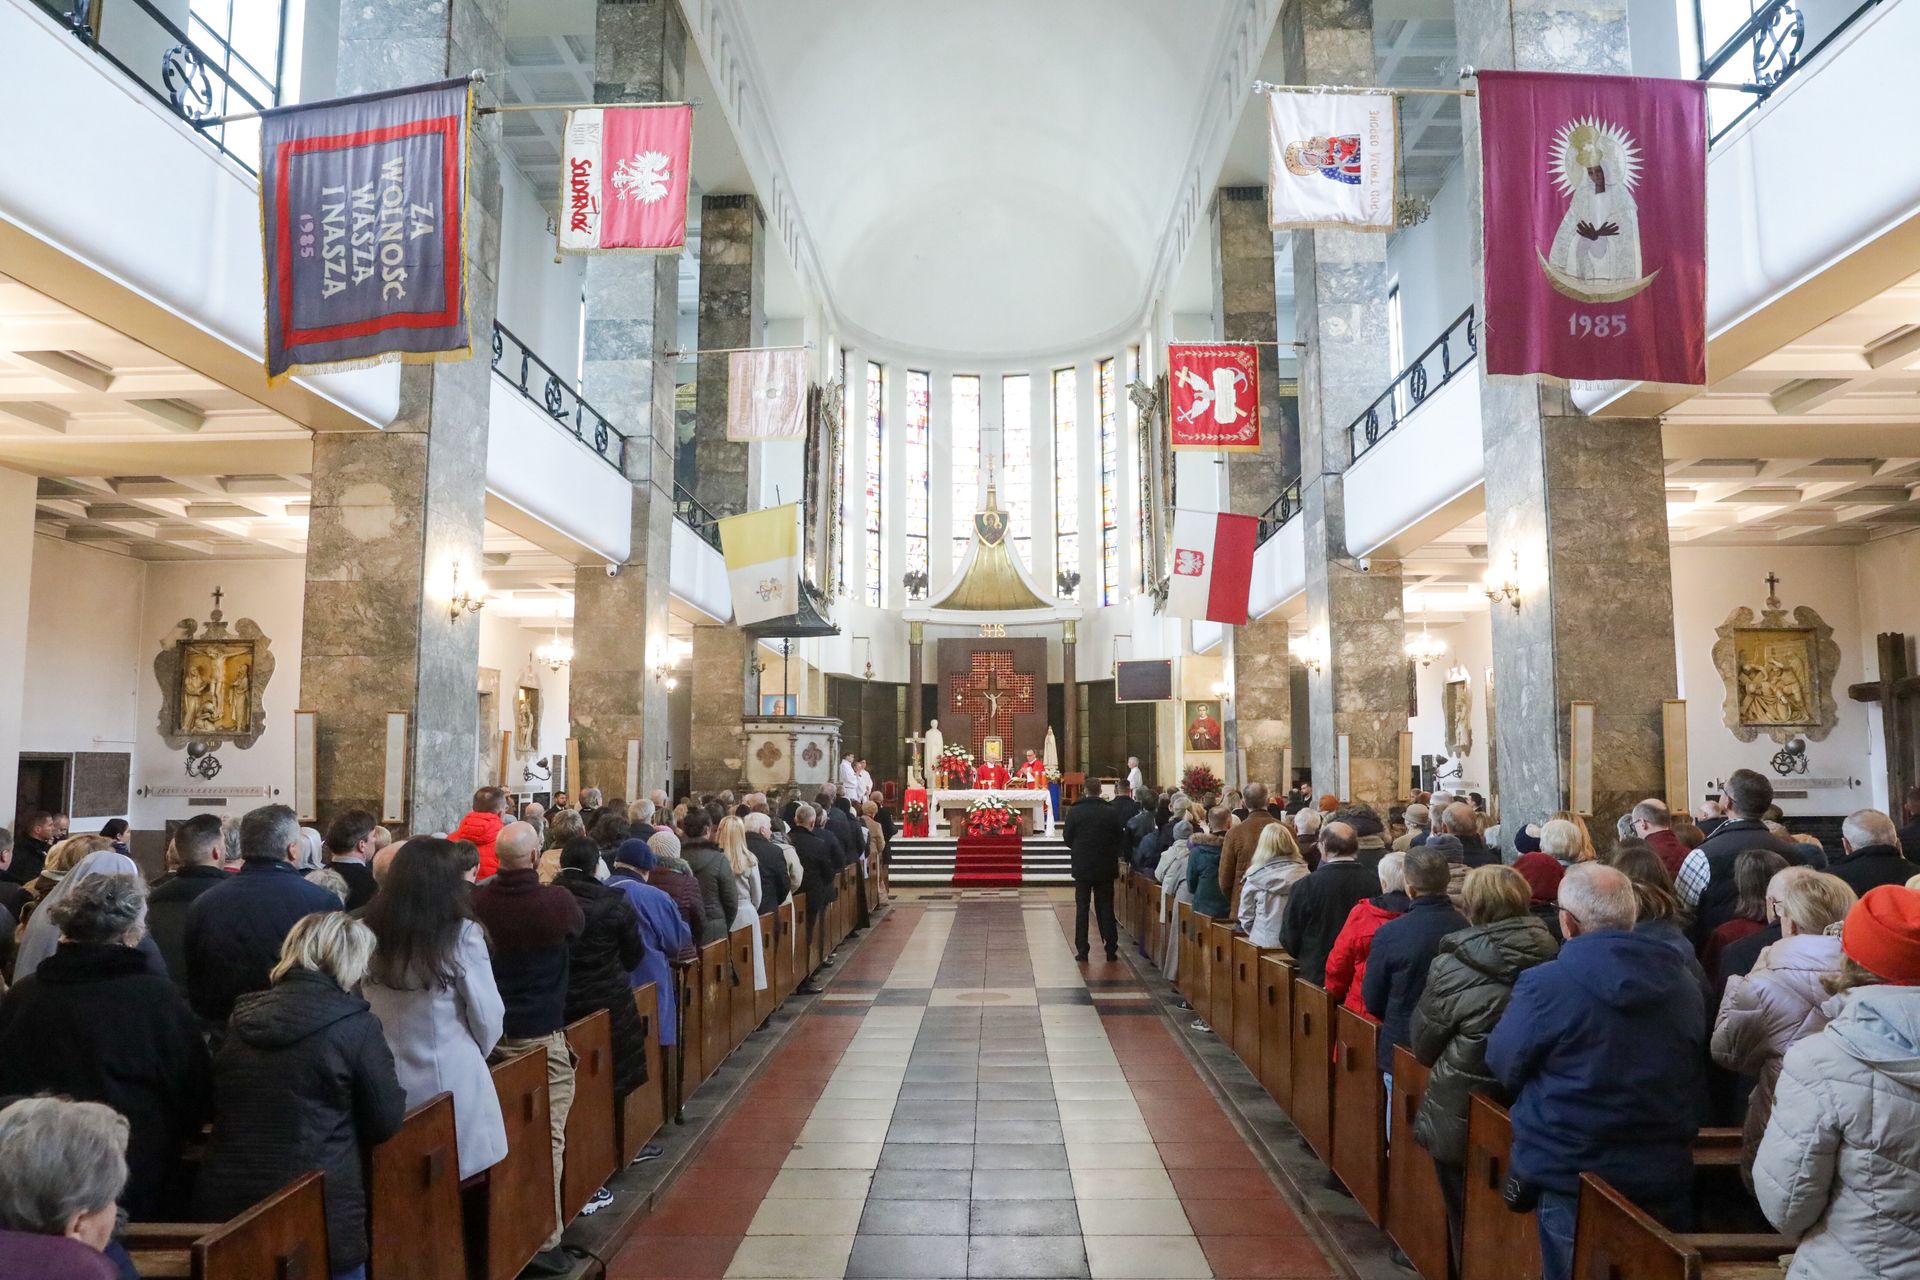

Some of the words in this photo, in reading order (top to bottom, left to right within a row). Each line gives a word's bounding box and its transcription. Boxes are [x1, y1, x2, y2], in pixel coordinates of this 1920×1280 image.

[322, 184, 345, 196] I
[300, 213, 315, 258] 1985
[379, 156, 408, 302] WOLNOŚĆ
[410, 202, 434, 241] ZA
[1568, 311, 1627, 340] 1985
